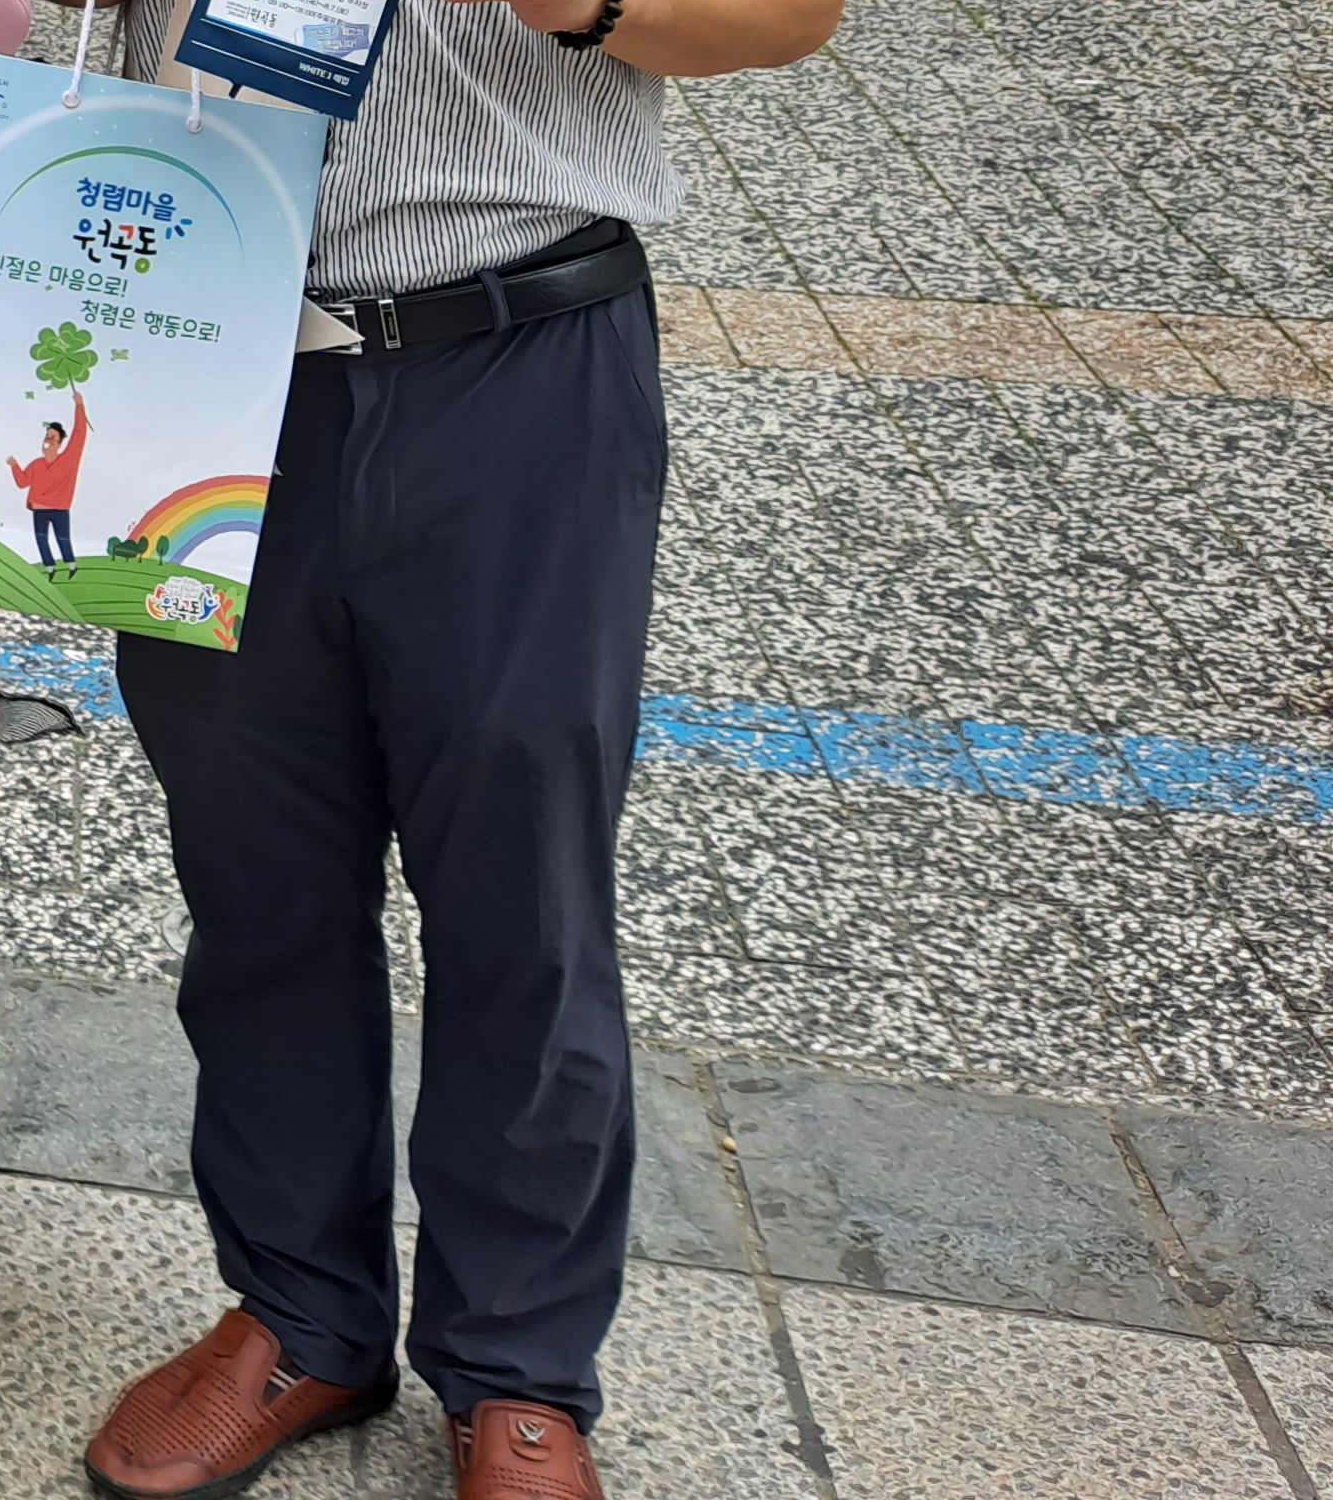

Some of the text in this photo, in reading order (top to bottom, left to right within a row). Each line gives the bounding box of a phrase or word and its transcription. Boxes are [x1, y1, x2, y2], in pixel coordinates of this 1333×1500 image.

[76, 177, 178, 222] 청렴마을
[73, 218, 159, 274] 원곡동
[48, 265, 128, 298] 마음으로!
[80, 299, 222, 344] 청렴은 행동으로!
